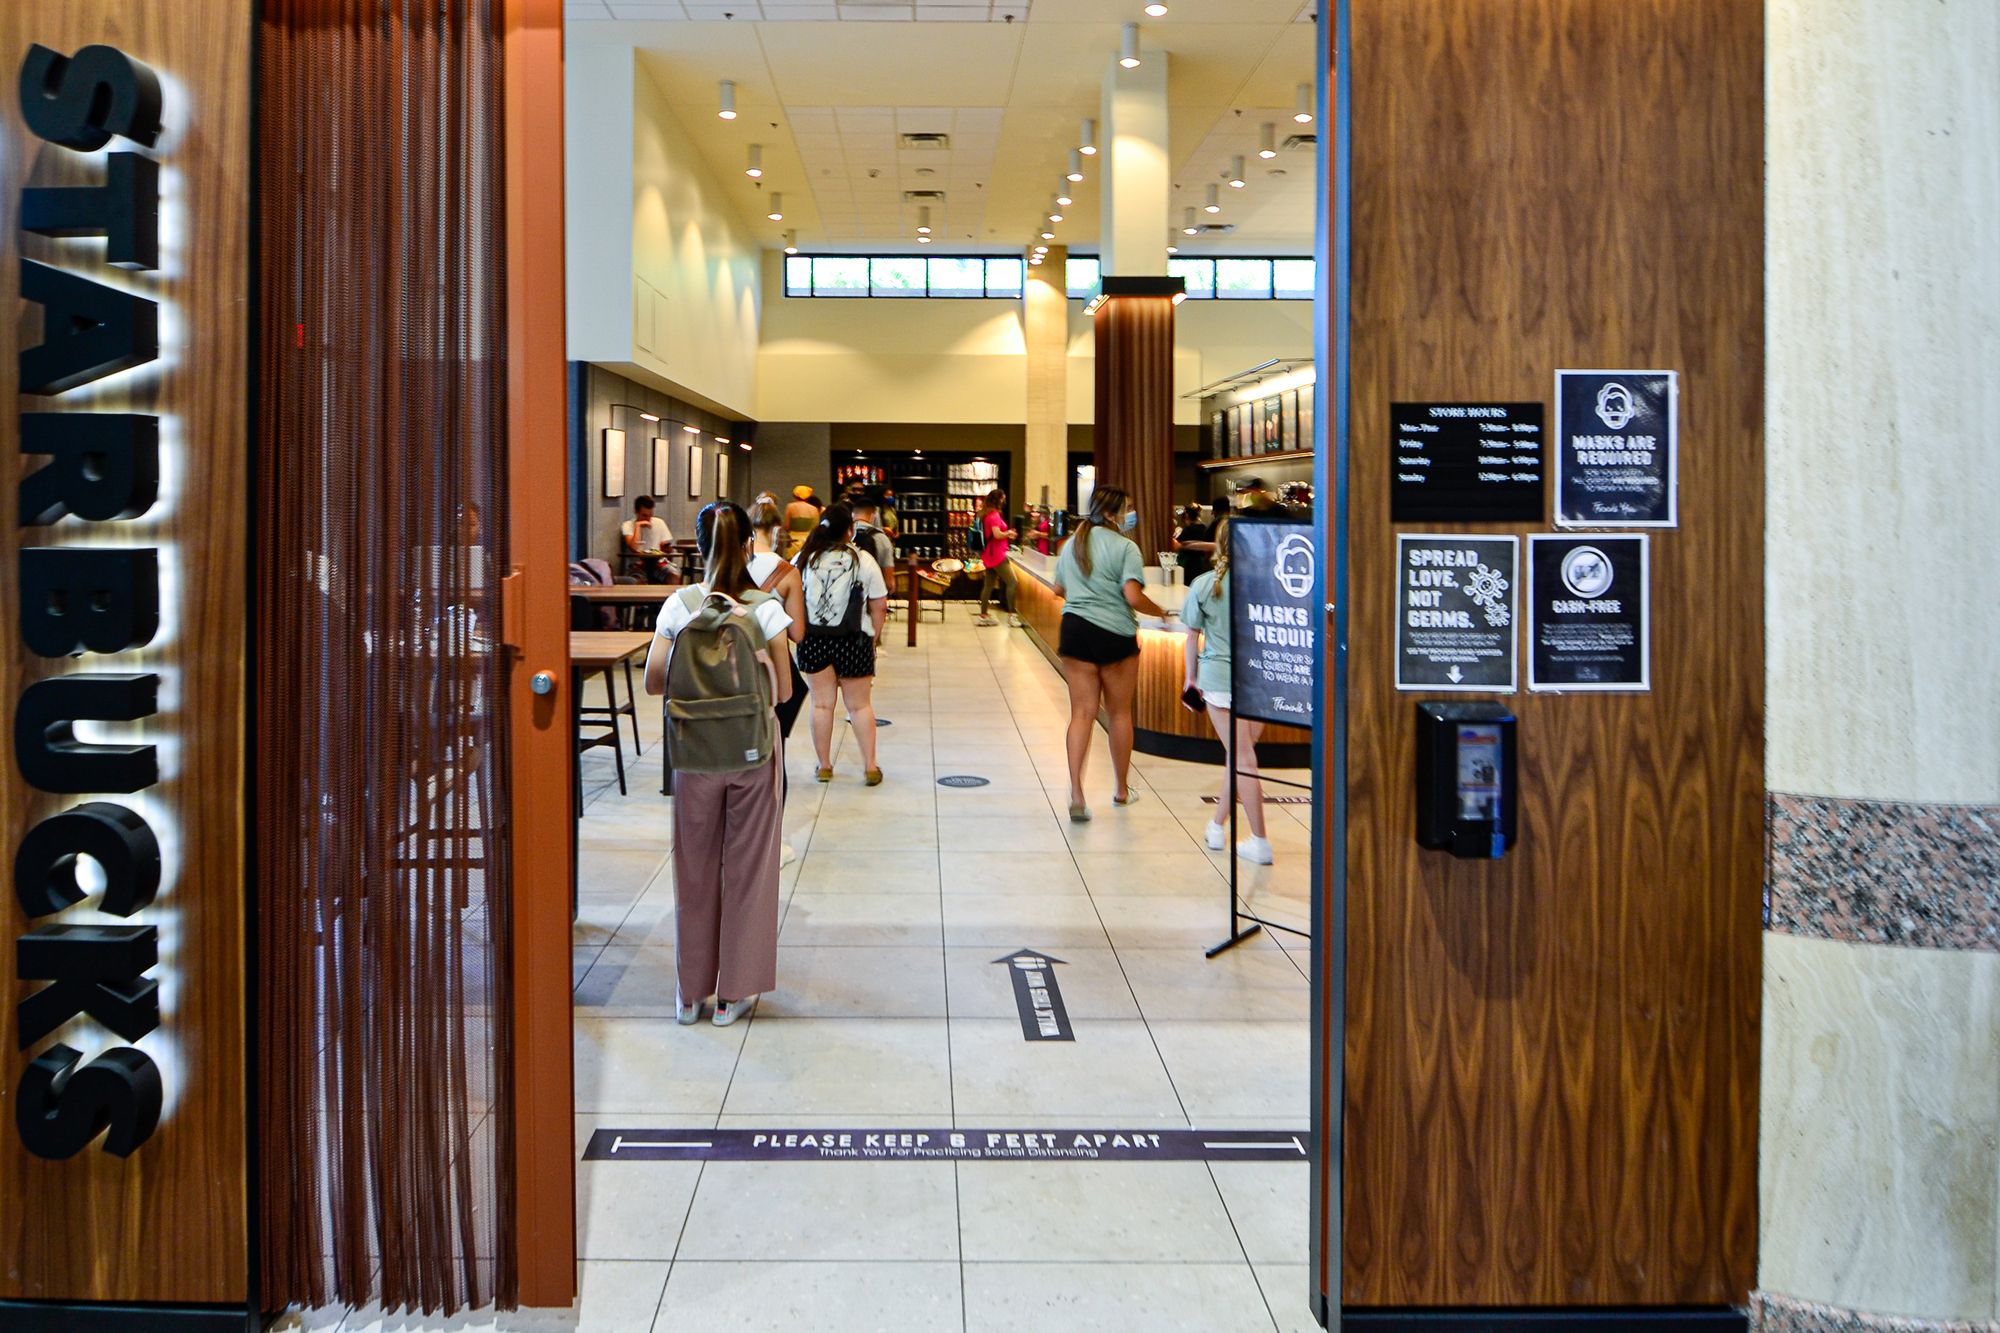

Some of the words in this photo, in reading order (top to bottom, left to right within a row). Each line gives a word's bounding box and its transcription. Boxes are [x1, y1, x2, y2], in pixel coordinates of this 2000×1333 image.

[1429, 407, 1467, 418] STORE
[1467, 407, 1507, 418] HOURS
[1572, 435, 1625, 450] MASKS
[1626, 435, 1656, 450] ARE
[1398, 456, 1432, 467] Saturday
[1577, 451, 1652, 467] REQUIRED
[1398, 473, 1426, 483] Sunday
[1408, 549, 1478, 567] SPREAD
[1408, 570, 1459, 589] LOVE,
[15, 42, 165, 1160] STARBUCKS
[1408, 590, 1442, 607] NOT
[1552, 599, 1622, 613] CASH-FREE
[1248, 603, 1308, 627] MASKS
[1407, 610, 1475, 629] GERMS.
[1262, 649, 1280, 661] FOR
[1280, 652, 1304, 664] YOUR
[1248, 658, 1263, 670] ALL
[1263, 660, 1292, 674] GUESTS
[1293, 665, 1311, 676] ARE
[1262, 670, 1275, 681] TO
[1276, 673, 1300, 685] WEAR
[1272, 696, 1306, 714] Thank
[753, 1133, 852, 1148] PLEASE
[865, 1133, 930, 1148] KEEP
[950, 1133, 965, 1148] 6
[987, 1133, 1056, 1148] FEET
[1073, 1133, 1161, 1149] APART
[819, 1147, 859, 1157] Thank
[862, 1147, 886, 1157] You
[890, 1147, 911, 1157] For
[913, 1147, 981, 1158] Practicing
[984, 1147, 1024, 1158] Social
[1027, 1147, 1100, 1158] Distancing
